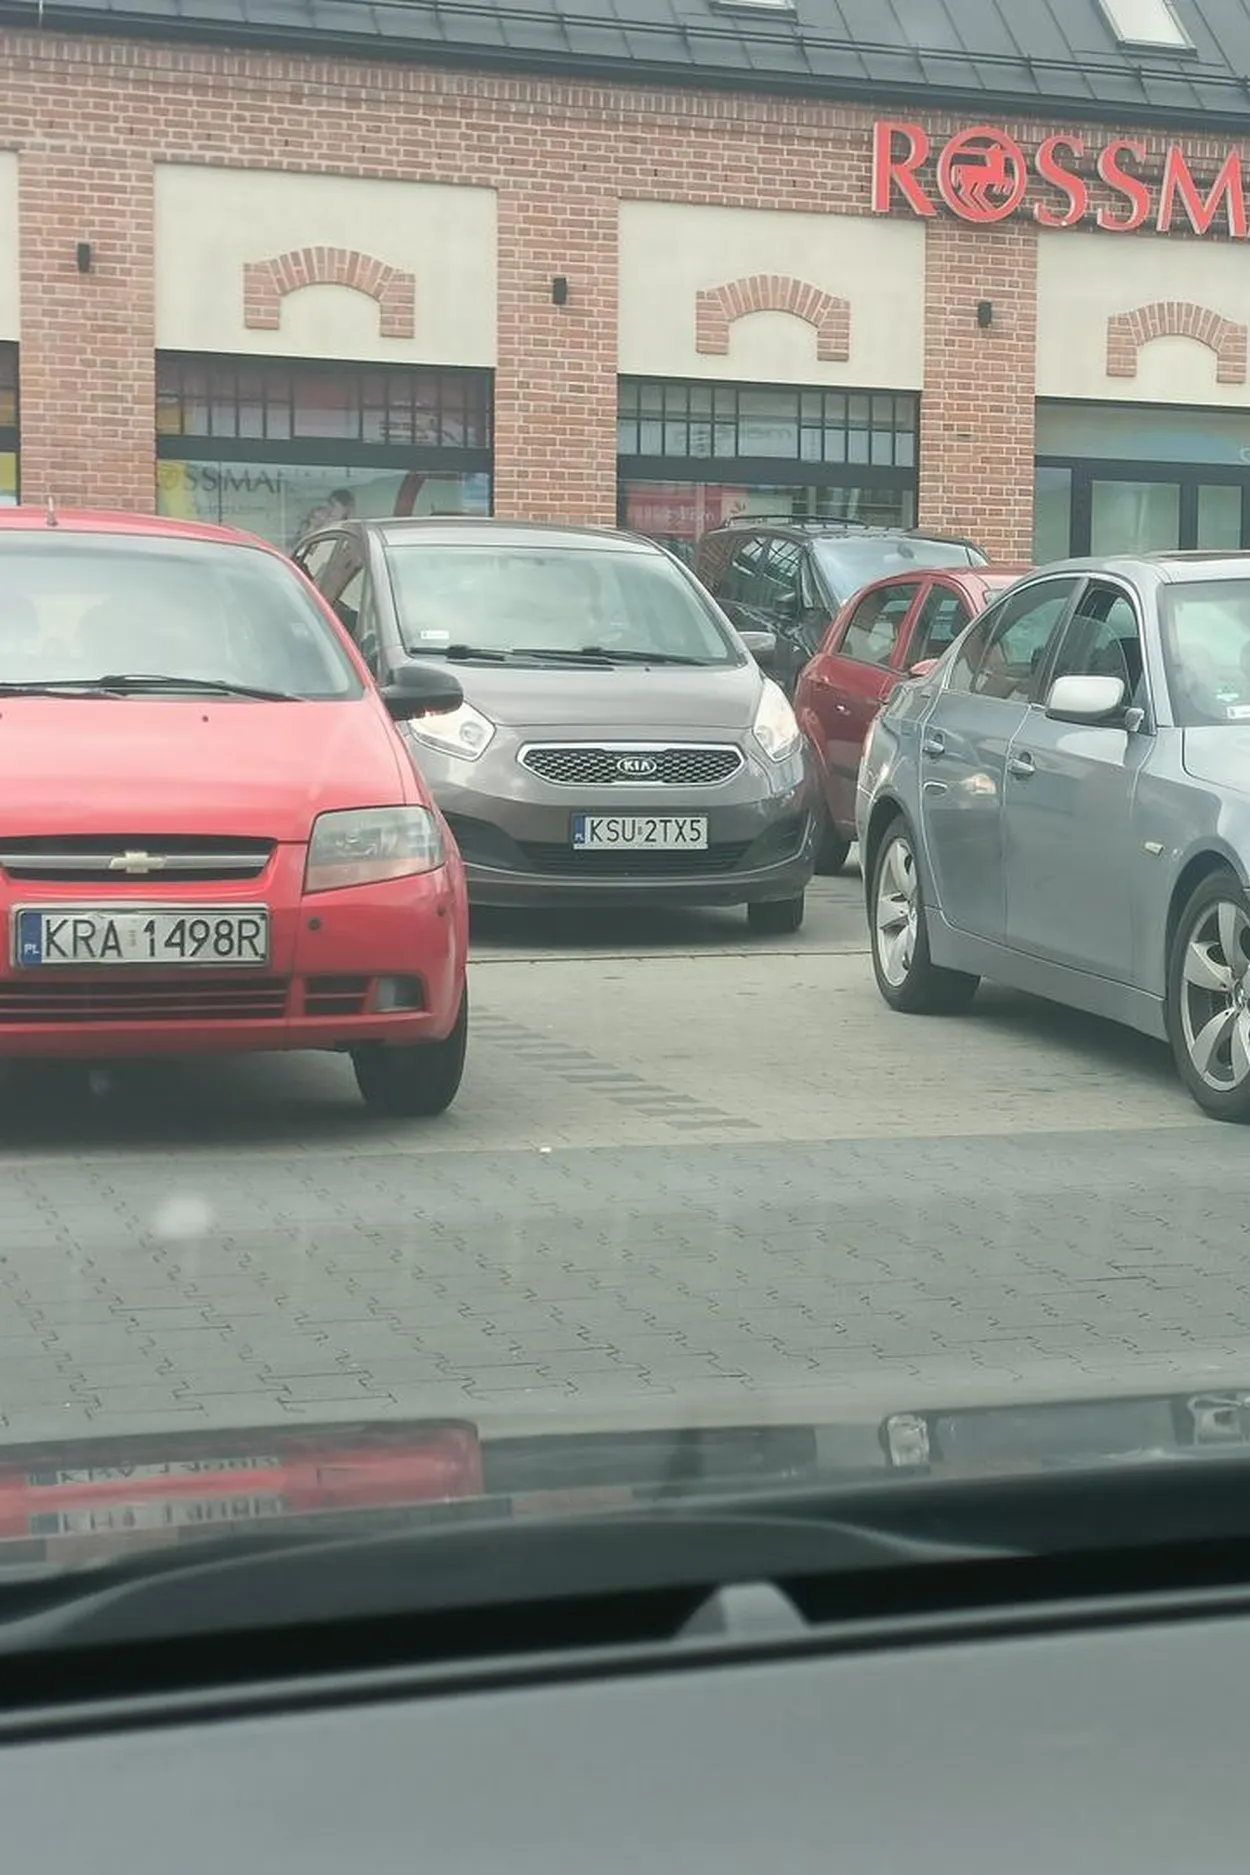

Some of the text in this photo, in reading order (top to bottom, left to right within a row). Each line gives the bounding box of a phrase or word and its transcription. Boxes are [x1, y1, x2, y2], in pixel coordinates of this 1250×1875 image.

[623, 760, 651, 771] KIA
[590, 819, 637, 842] KSU
[645, 818, 702, 843] 2TX5
[45, 917, 262, 958] KRA 1498R
